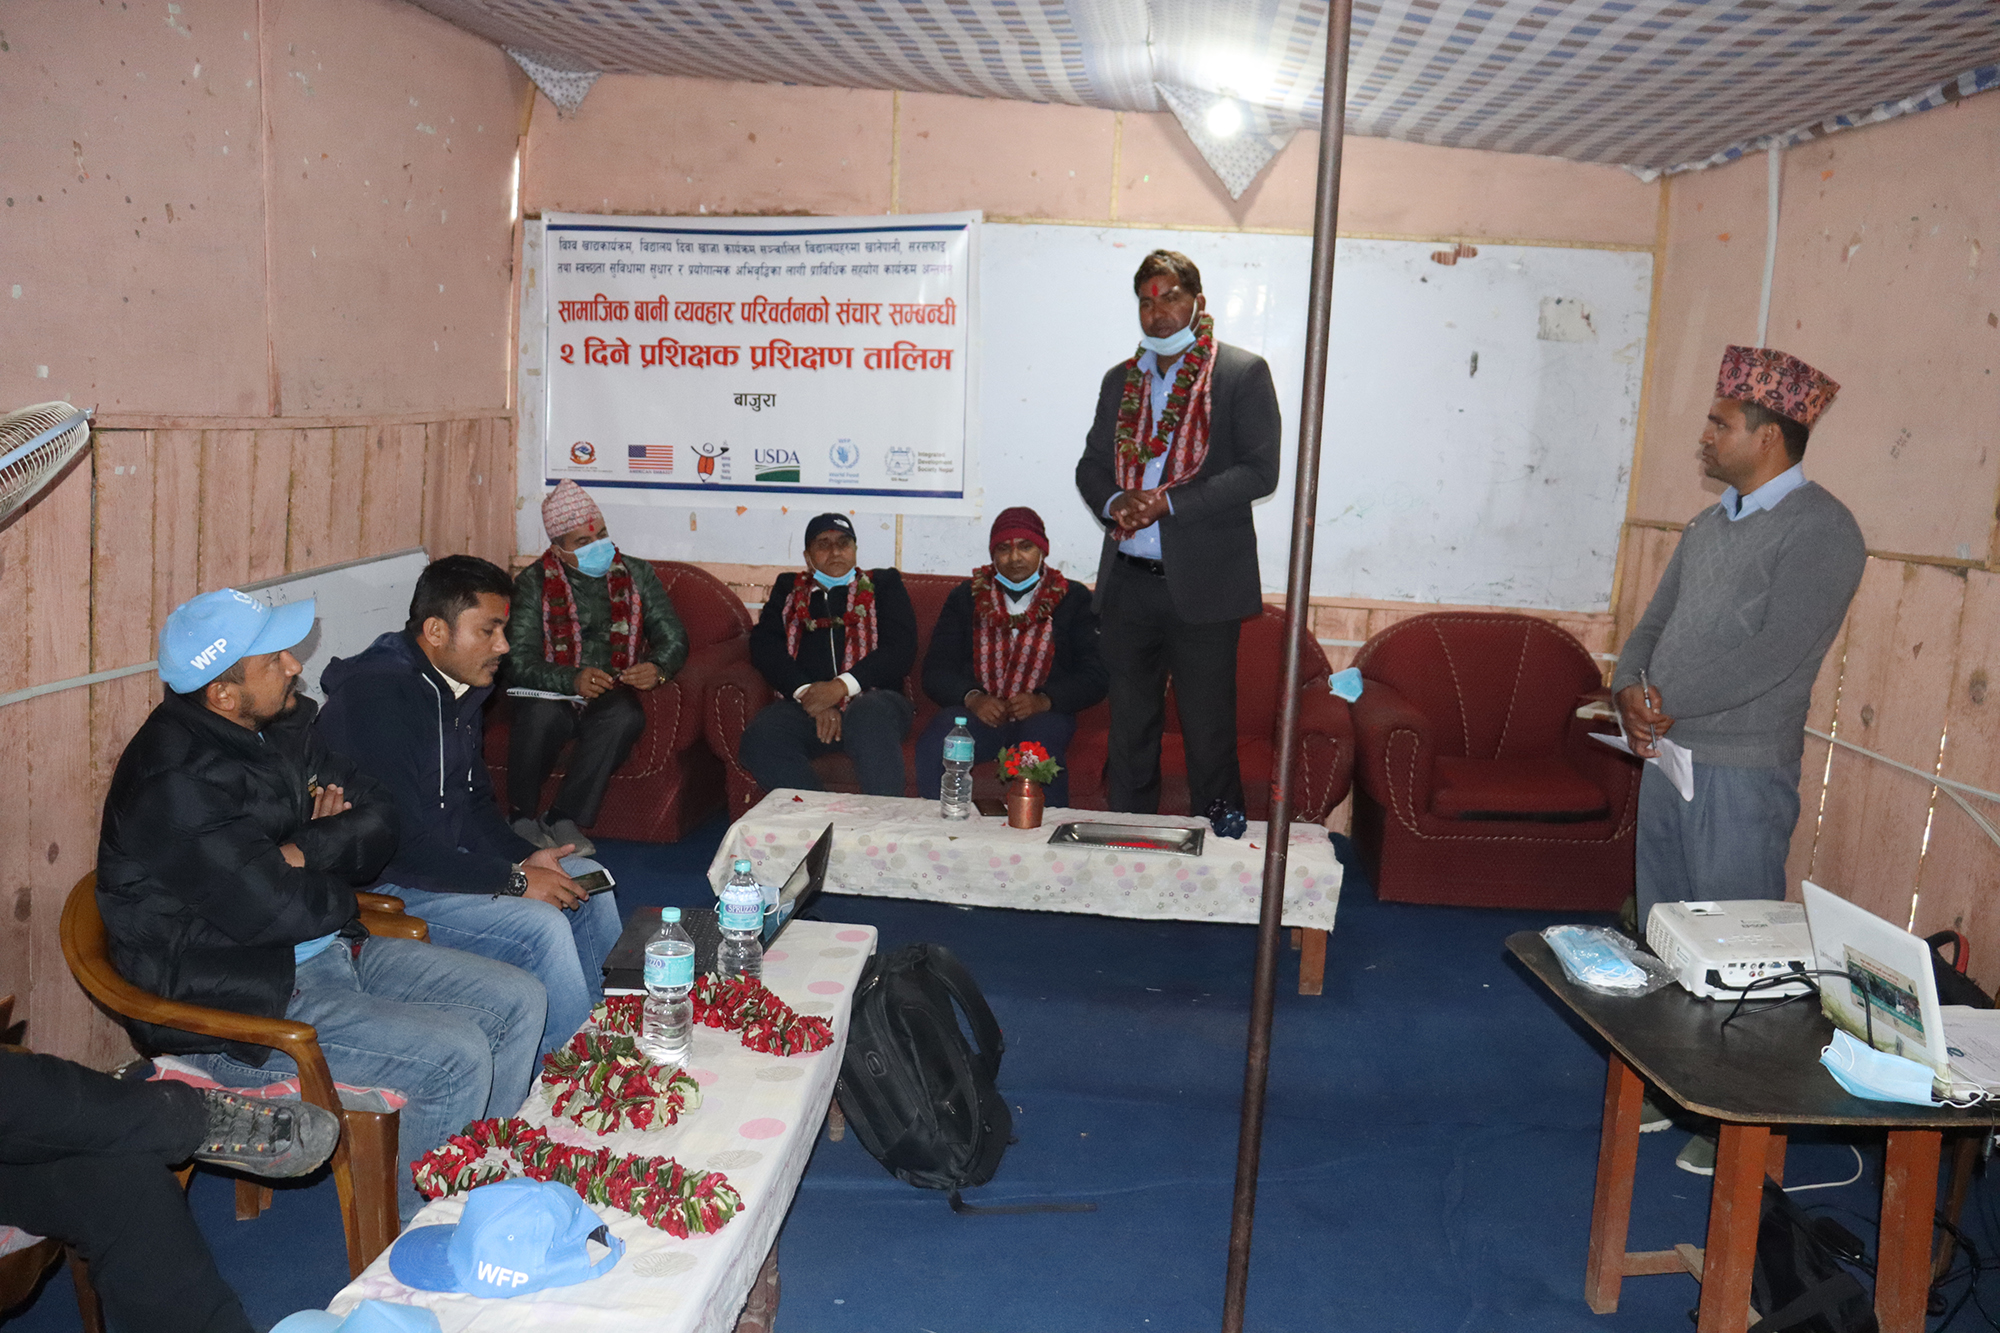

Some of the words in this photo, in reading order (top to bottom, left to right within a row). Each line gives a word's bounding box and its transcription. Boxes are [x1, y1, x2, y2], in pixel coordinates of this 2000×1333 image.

[676, 238, 694, 253] दिवा
[678, 264, 683, 275] र
[558, 293, 629, 324] सामाजिक
[635, 294, 669, 322] बानी
[674, 301, 736, 324] व्यवहार
[741, 294, 830, 324] परिवर्तनको
[836, 296, 882, 325] संचार
[889, 296, 957, 325] सम्बन्धी
[559, 344, 574, 364] २
[584, 337, 630, 365] दिने
[640, 337, 740, 369] प्रशिक्षक
[750, 338, 854, 370] प्रशिक्षण
[863, 340, 953, 370] तालिम
[733, 392, 777, 412] बाजुरा
[755, 449, 800, 464] USDA
[190, 638, 227, 670] WFP
[727, 903, 759, 914] SPRUZZO
[478, 1260, 529, 1288] WFP
